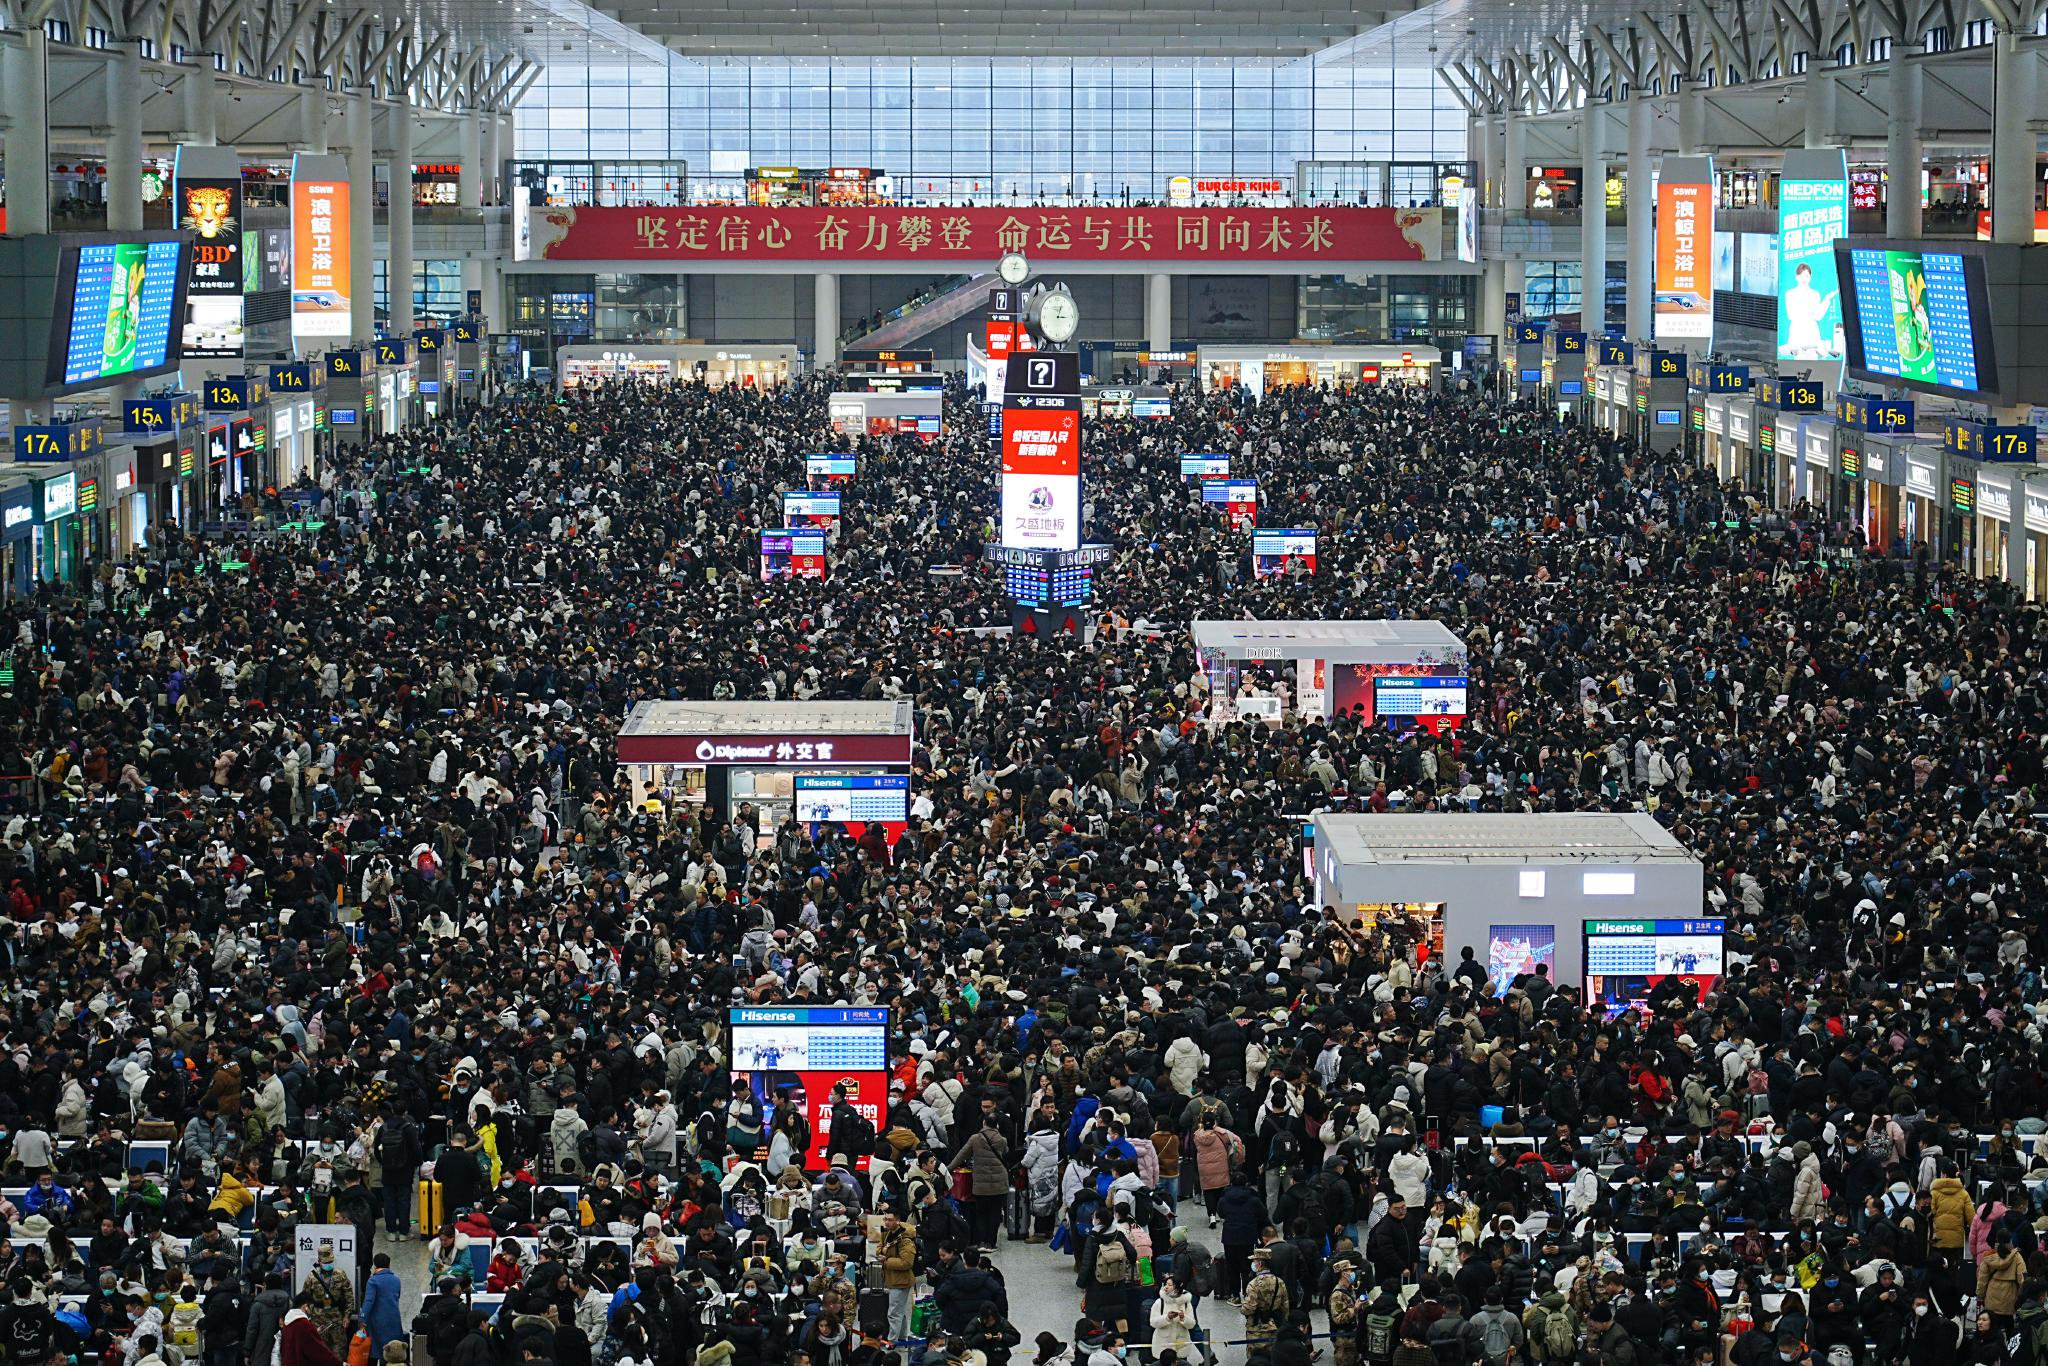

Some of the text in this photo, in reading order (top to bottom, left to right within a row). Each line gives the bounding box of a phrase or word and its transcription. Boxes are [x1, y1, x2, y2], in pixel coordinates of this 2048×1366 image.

[1197, 181, 1281, 192] BURGER KING
[1673, 188, 1698, 196] SSWW
[1783, 183, 1844, 196] NEDFON
[1853, 185, 1876, 196] 港式
[1853, 196, 1876, 208] 快餐
[310, 198, 333, 271] 浪鲸卫浴
[634, 214, 1335, 253] 坚定信心 奋力攀登 命运与共 同向未来
[1674, 200, 1696, 272] 浪鲸卫浴
[196, 263, 220, 277] 家居
[457, 327, 471, 339] 3A
[1525, 328, 1538, 340] 3B
[420, 336, 435, 349] 5A
[1565, 337, 1579, 349] 5B
[379, 346, 396, 360] 7A
[1609, 347, 1625, 361] 7B
[334, 358, 351, 372] 9A
[1661, 359, 1677, 373] 9B
[277, 371, 303, 387] 11A
[1717, 372, 1742, 387] 11B
[211, 387, 240, 404] 13A
[1035, 397, 1065, 407] 12306
[1788, 388, 1816, 404] 13B
[131, 407, 163, 425] 15A
[1875, 408, 1907, 425] 15B
[24, 434, 60, 454] 17A
[1993, 434, 2028, 454] 17B
[1016, 517, 1065, 531] 久盛地板
[1246, 647, 1283, 660] DIOR
[1382, 678, 1415, 687] Hisense
[715, 742, 833, 760] Diplomat 外交官
[803, 778, 843, 788] Hisense
[1596, 922, 1644, 934] Hisense
[741, 1011, 796, 1022] Hisense
[299, 1237, 353, 1252] 检票口
